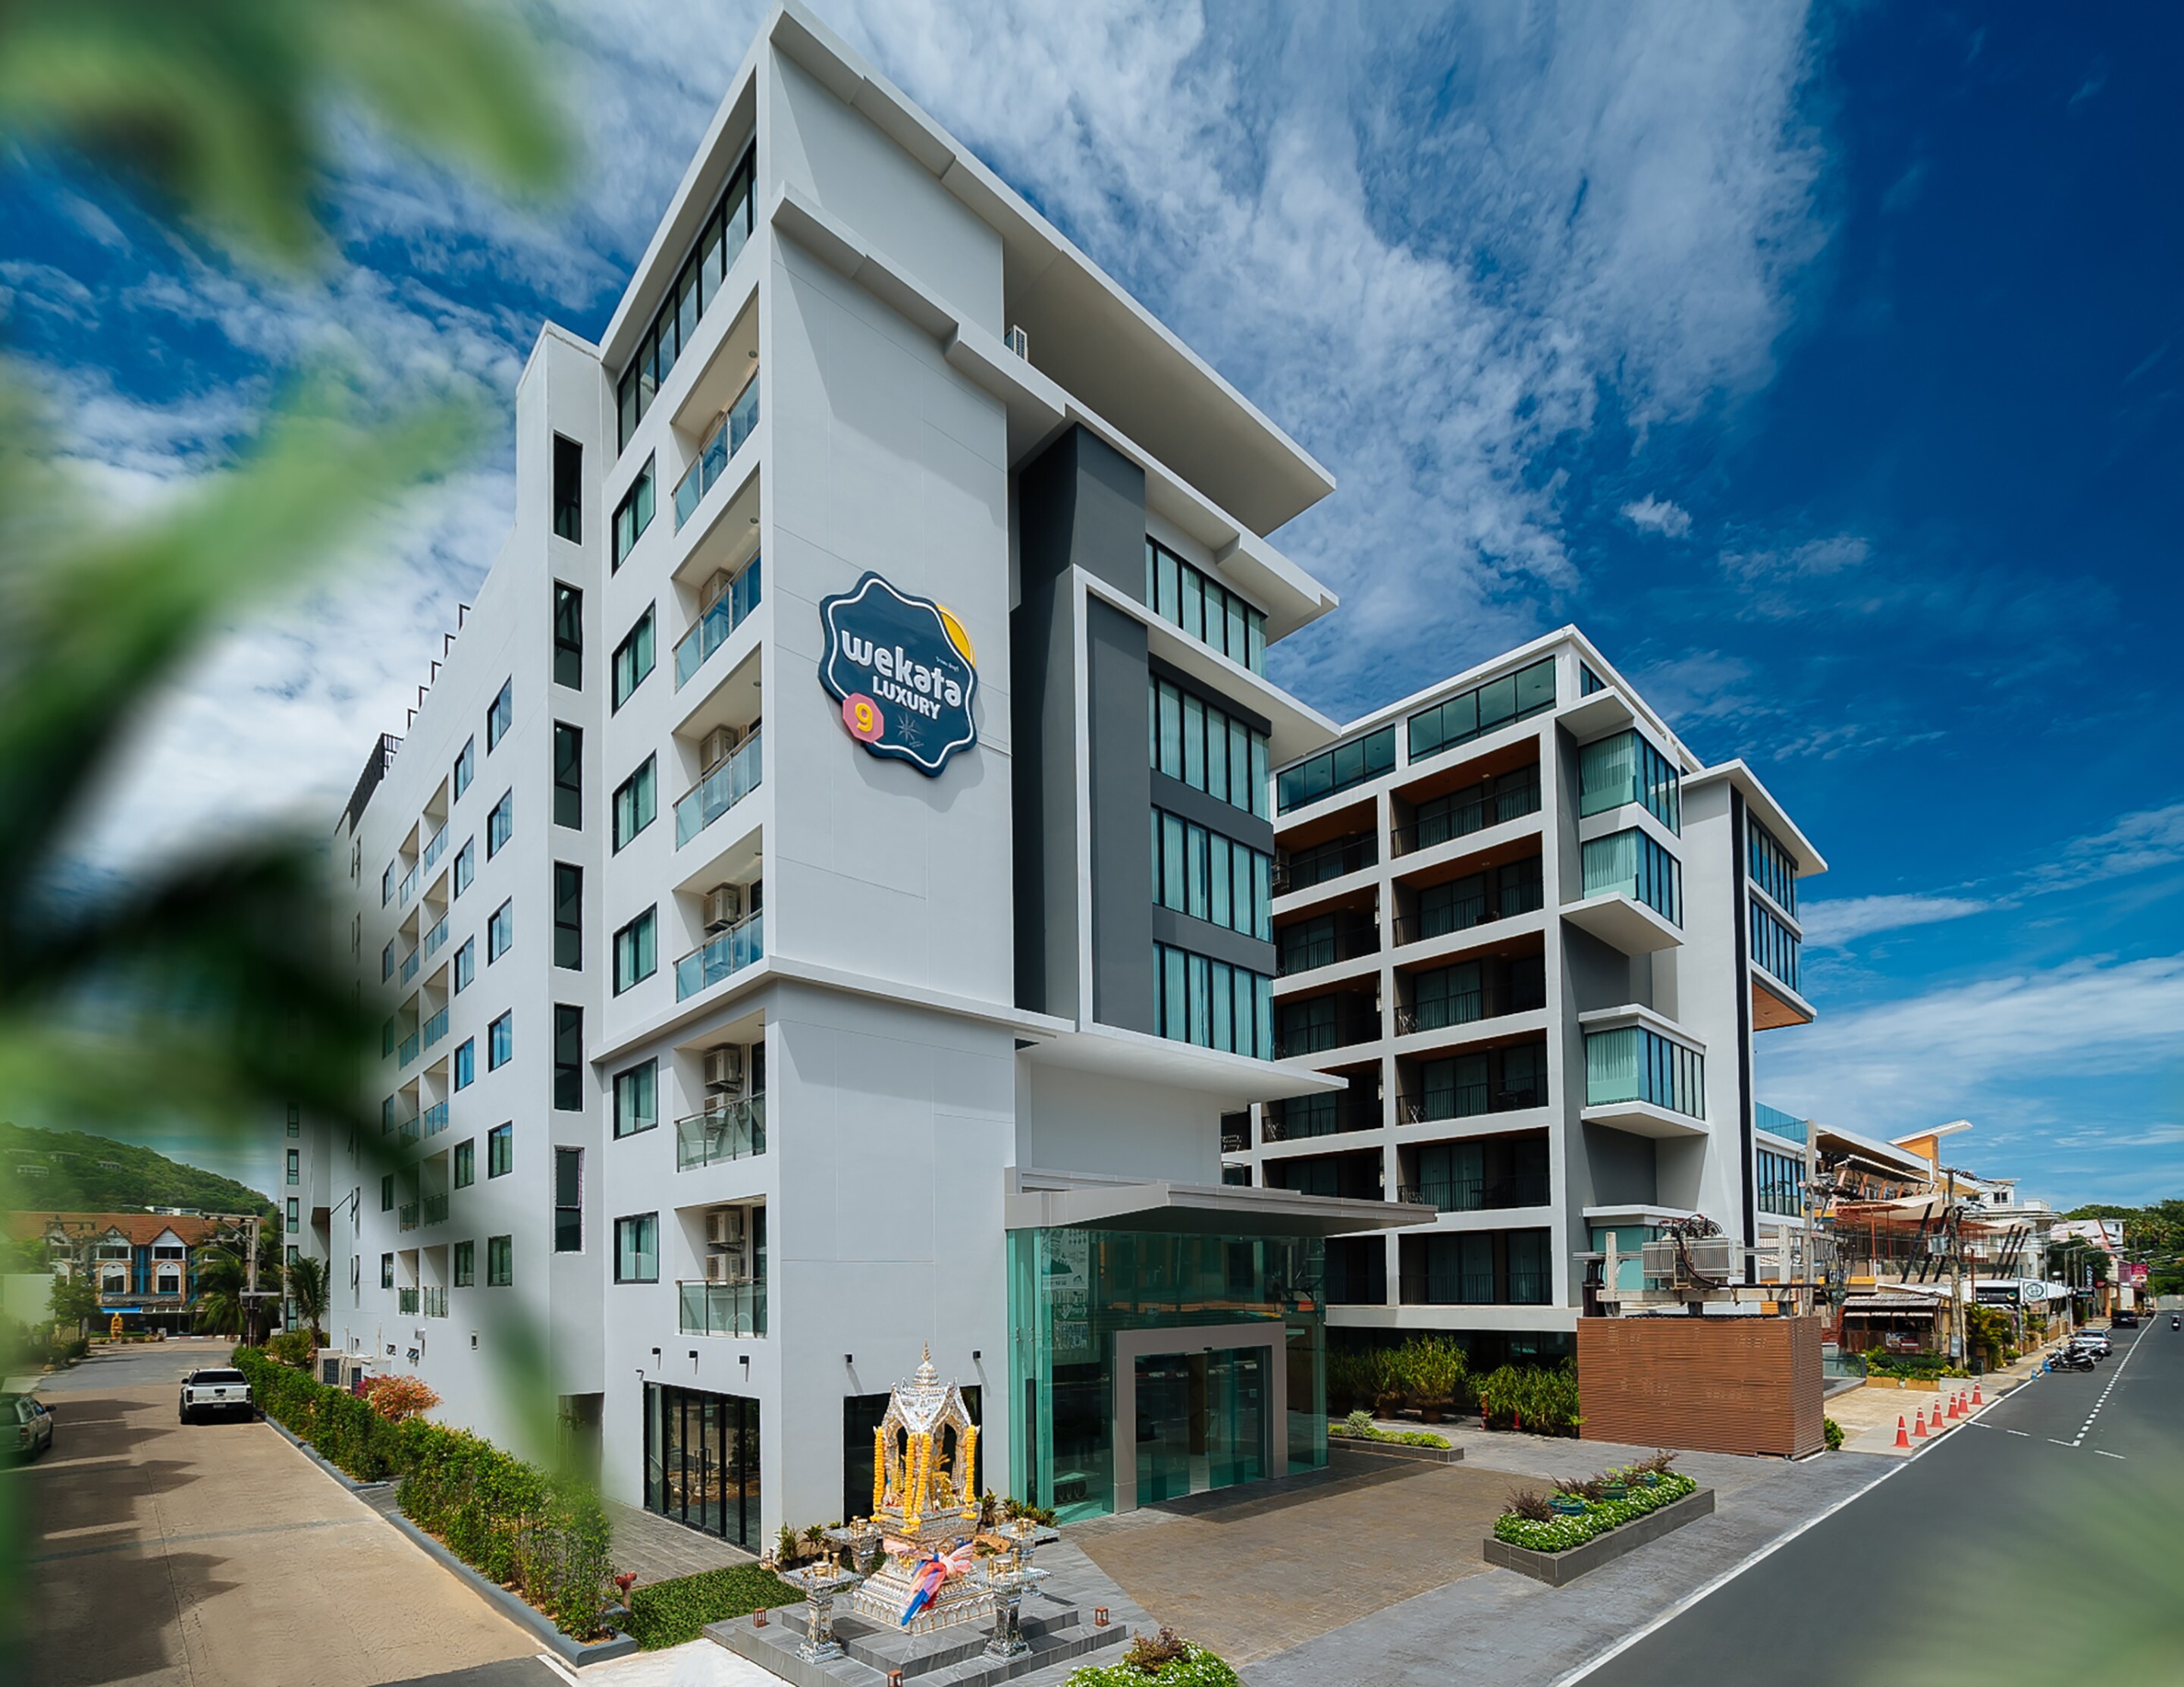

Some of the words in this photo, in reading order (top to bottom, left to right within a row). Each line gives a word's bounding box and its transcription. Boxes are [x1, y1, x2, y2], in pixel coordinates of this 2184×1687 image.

[841, 629, 962, 707] wekata
[855, 702, 874, 732] 9
[873, 676, 941, 720] LUXURY
